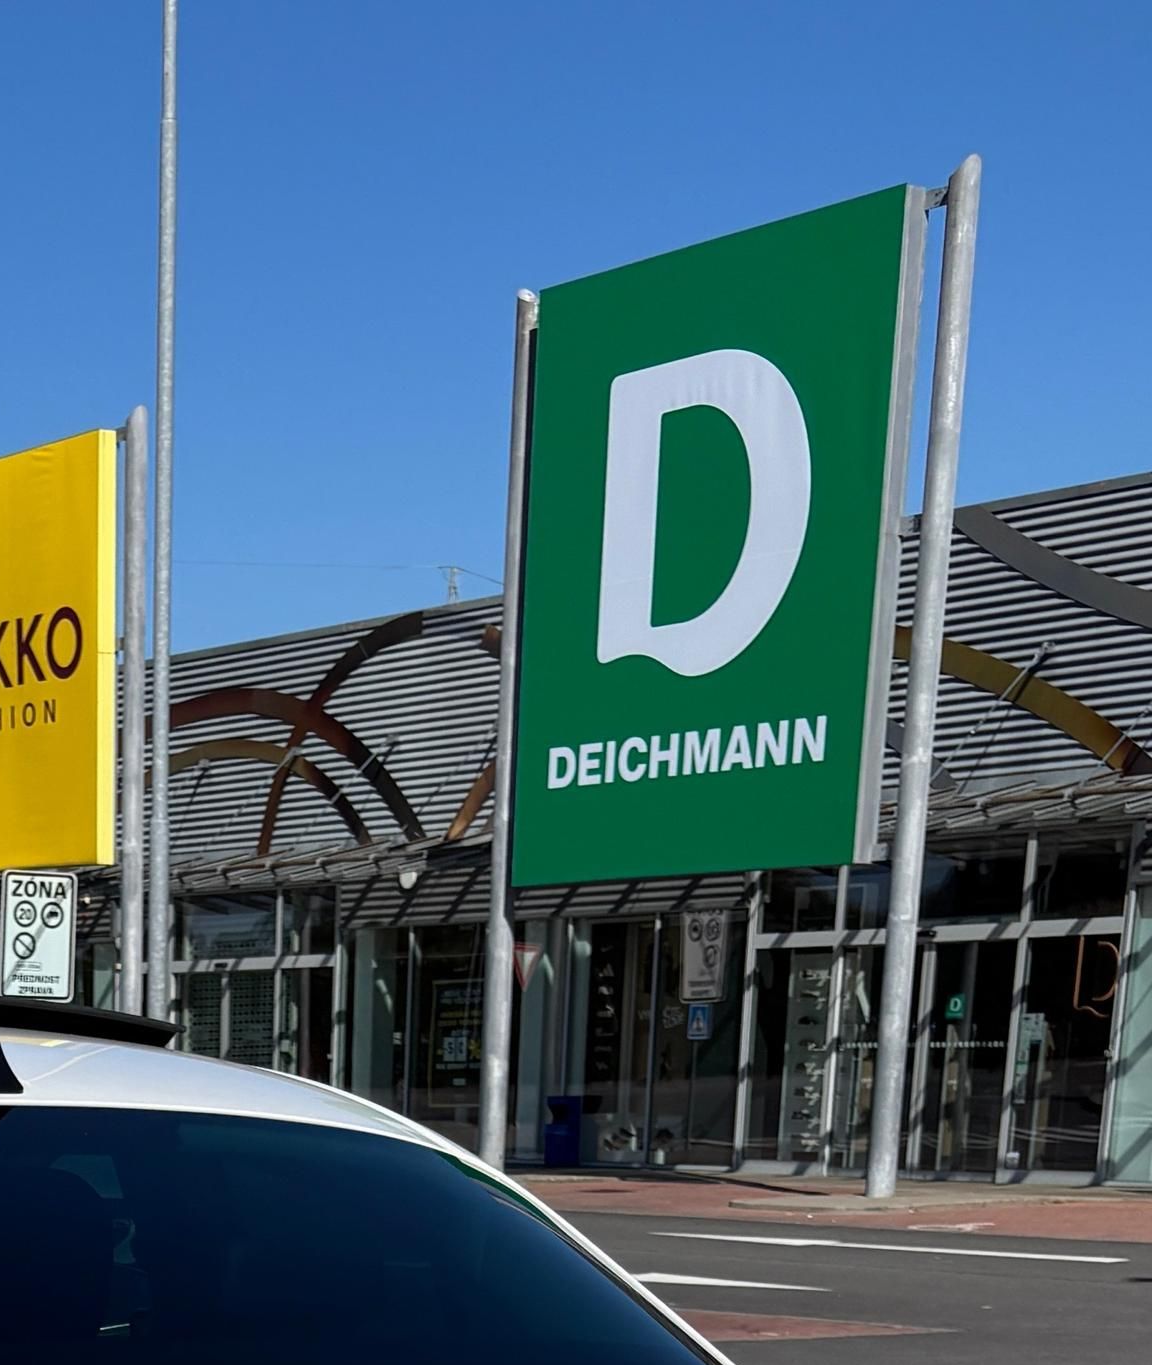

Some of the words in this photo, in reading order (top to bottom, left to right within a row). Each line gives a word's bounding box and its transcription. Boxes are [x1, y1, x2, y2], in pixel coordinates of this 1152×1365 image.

[597, 348, 812, 677] D
[547, 714, 828, 790] DEICHMANN
[11, 877, 67, 899] ZÓNA
